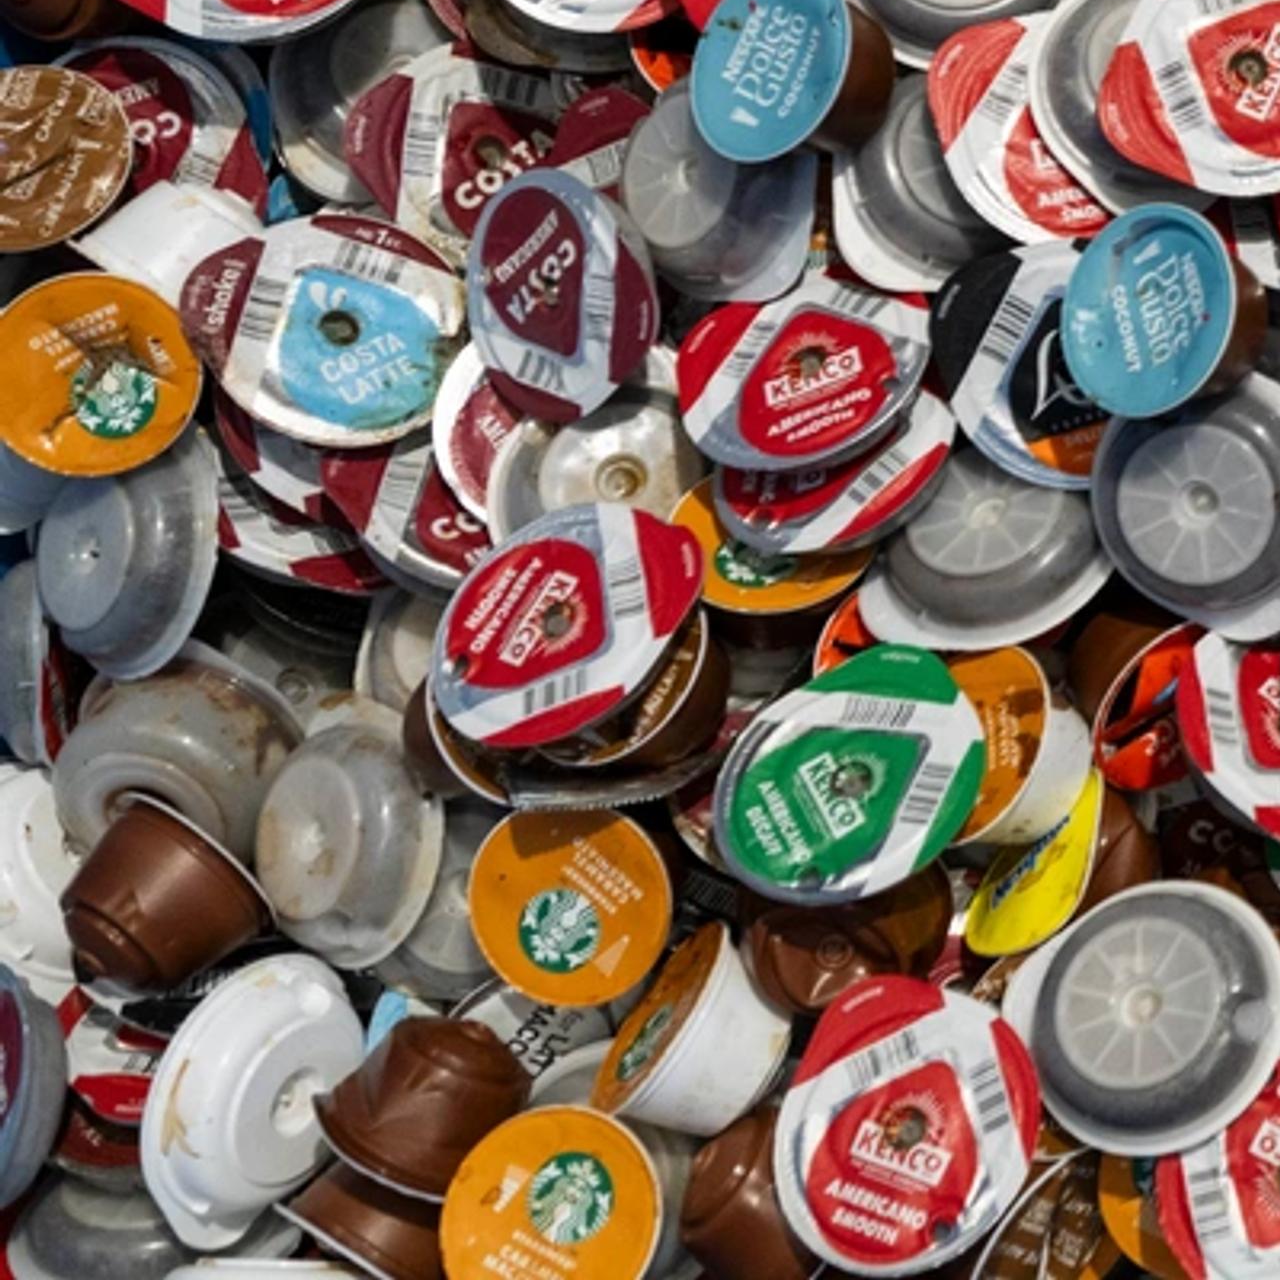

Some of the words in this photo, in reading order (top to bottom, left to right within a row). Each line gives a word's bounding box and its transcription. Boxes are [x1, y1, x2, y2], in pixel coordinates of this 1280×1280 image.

[737, 5, 790, 98] Dolce
[760, 16, 806, 104] Gusto
[779, 32, 818, 116] COCONUT
[498, 213, 558, 283] AMERICANO
[1112, 286, 1141, 371] COCONUT
[1138, 277, 1173, 365] Gusto
[1160, 256, 1192, 347] Dolce
[322, 334, 405, 382] COSTA
[339, 358, 416, 404] LATTE
[768, 390, 870, 435] AMERICANO
[788, 411, 853, 441] SMOOTH
[468, 568, 514, 627] SMOOTH
[472, 560, 539, 651] AMERICANO
[748, 809, 782, 856] DECAFF
[757, 782, 810, 861] AMERICANO
[829, 1182, 926, 1226] AMERICANO
[832, 1210, 897, 1244] SMOOTH
